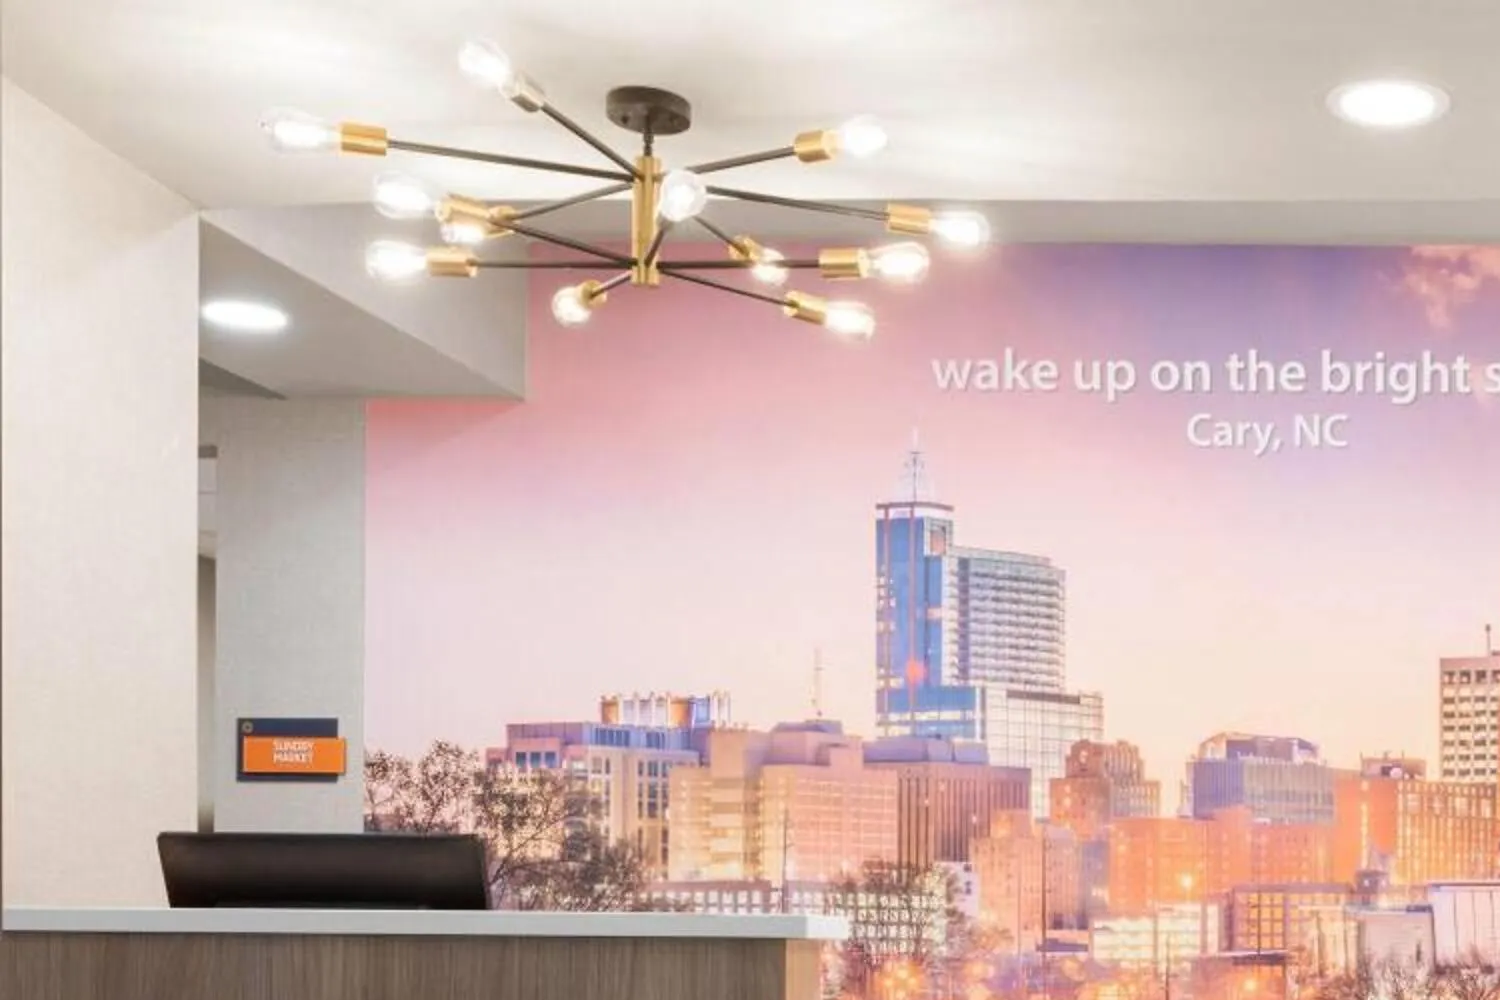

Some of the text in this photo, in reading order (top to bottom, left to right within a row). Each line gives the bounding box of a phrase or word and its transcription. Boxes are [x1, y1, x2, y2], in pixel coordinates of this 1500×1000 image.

[932, 347, 1059, 391] wake
[1073, 358, 1137, 402] up
[1150, 358, 1212, 392] on
[1225, 349, 1307, 392] the
[1321, 349, 1471, 405] bright
[1187, 413, 1349, 456] Cary, NC
